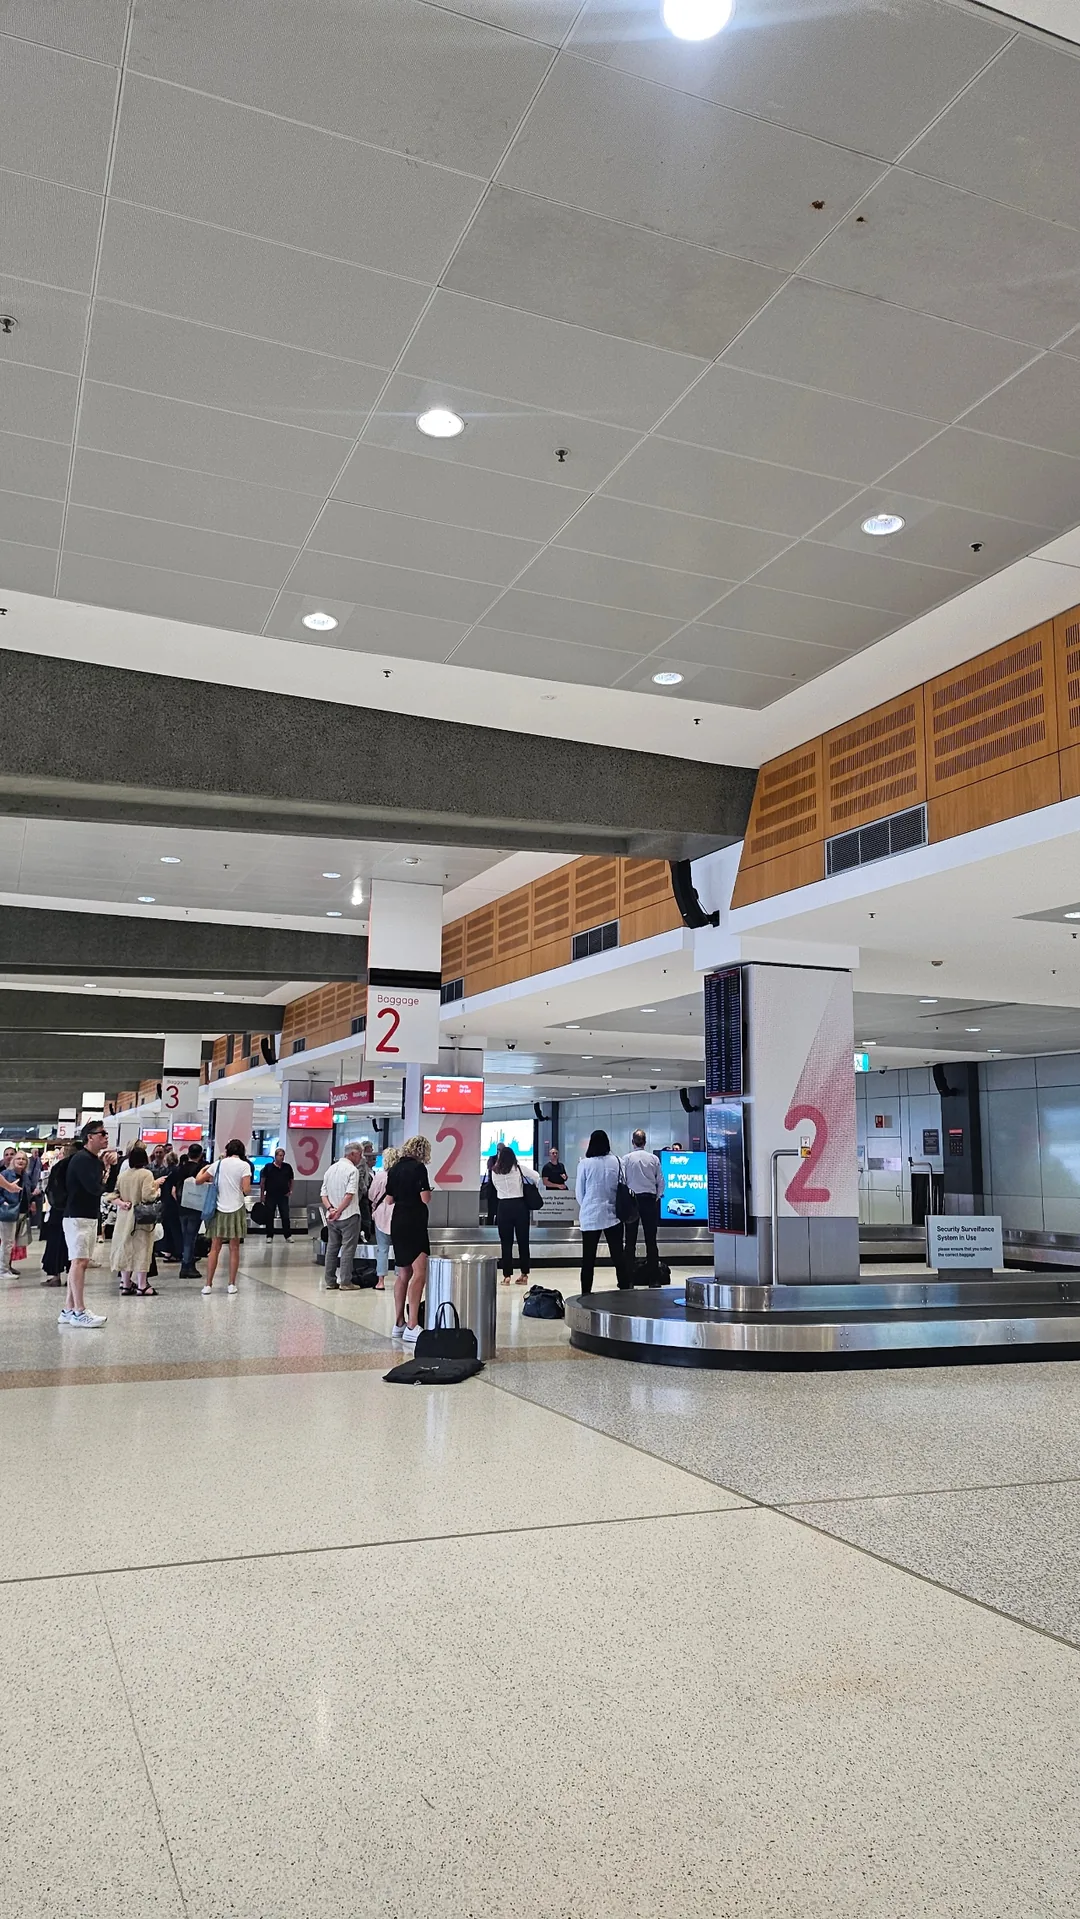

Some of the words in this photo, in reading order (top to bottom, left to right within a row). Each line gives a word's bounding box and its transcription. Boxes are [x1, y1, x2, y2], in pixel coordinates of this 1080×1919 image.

[377, 994, 419, 1006] Baggage
[375, 1007, 400, 1053] 2
[424, 1083, 431, 1094] 2
[165, 1085, 179, 1109] 3
[291, 1108, 297, 1116] 3
[59, 1125, 66, 1137] 5
[297, 1136, 319, 1176] 3
[434, 1127, 463, 1183] 2
[784, 1105, 830, 1202] 2
[668, 1173, 676, 1181] IF
[677, 1173, 704, 1182] YOU'RE
[668, 1181, 687, 1189] HALF
[937, 1225, 960, 1233] Security
[937, 1234, 958, 1242] System
